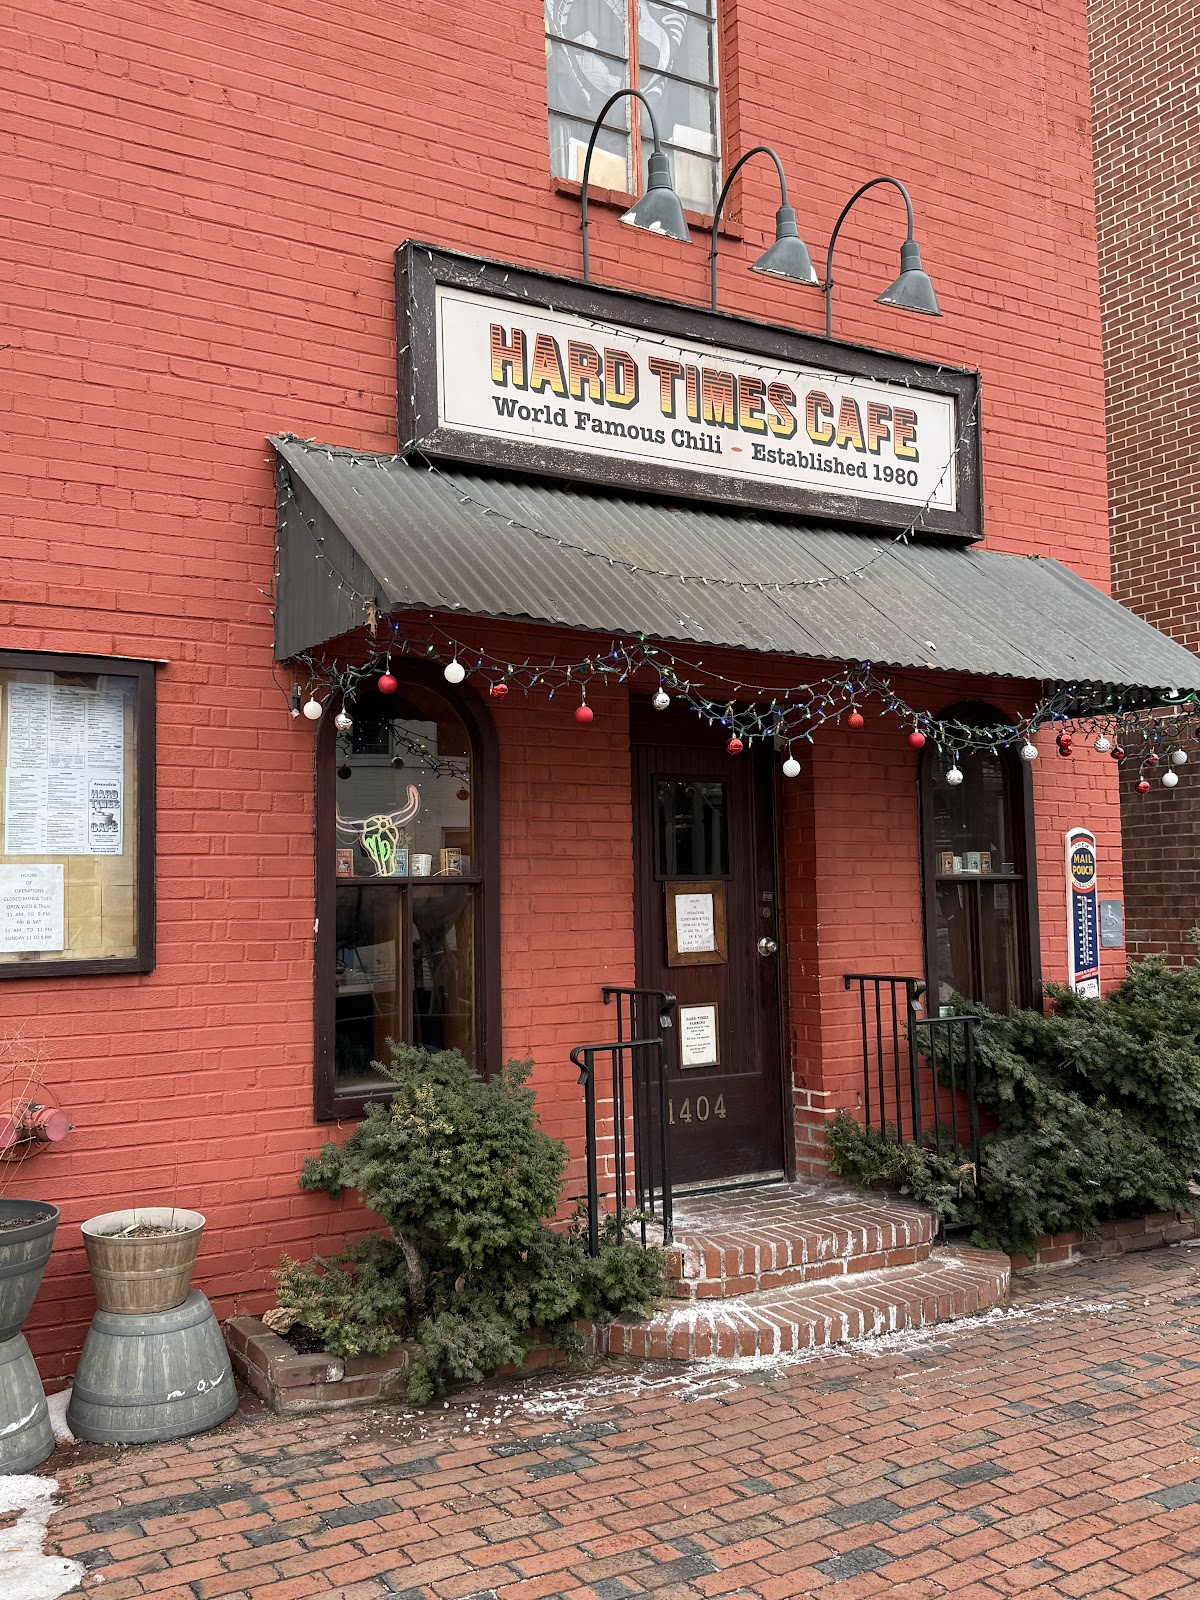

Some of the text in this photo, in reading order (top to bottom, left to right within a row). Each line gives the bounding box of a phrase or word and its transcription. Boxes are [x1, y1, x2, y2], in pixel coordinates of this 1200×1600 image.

[490, 323, 920, 463] HARD TIMES CAFE
[492, 396, 568, 427] World
[574, 411, 665, 444] Famous
[671, 428, 723, 454] Chili
[751, 443, 868, 479] Established
[873, 464, 919, 487] 1980
[91, 790, 119, 799] HARD
[89, 799, 120, 809] TIMES
[91, 822, 119, 833] CAFE
[1073, 853, 1093, 864] MAIL
[1072, 865, 1094, 875] POUCH
[1073, 879, 1094, 888] TOBACCO
[668, 1093, 726, 1125] 1404
